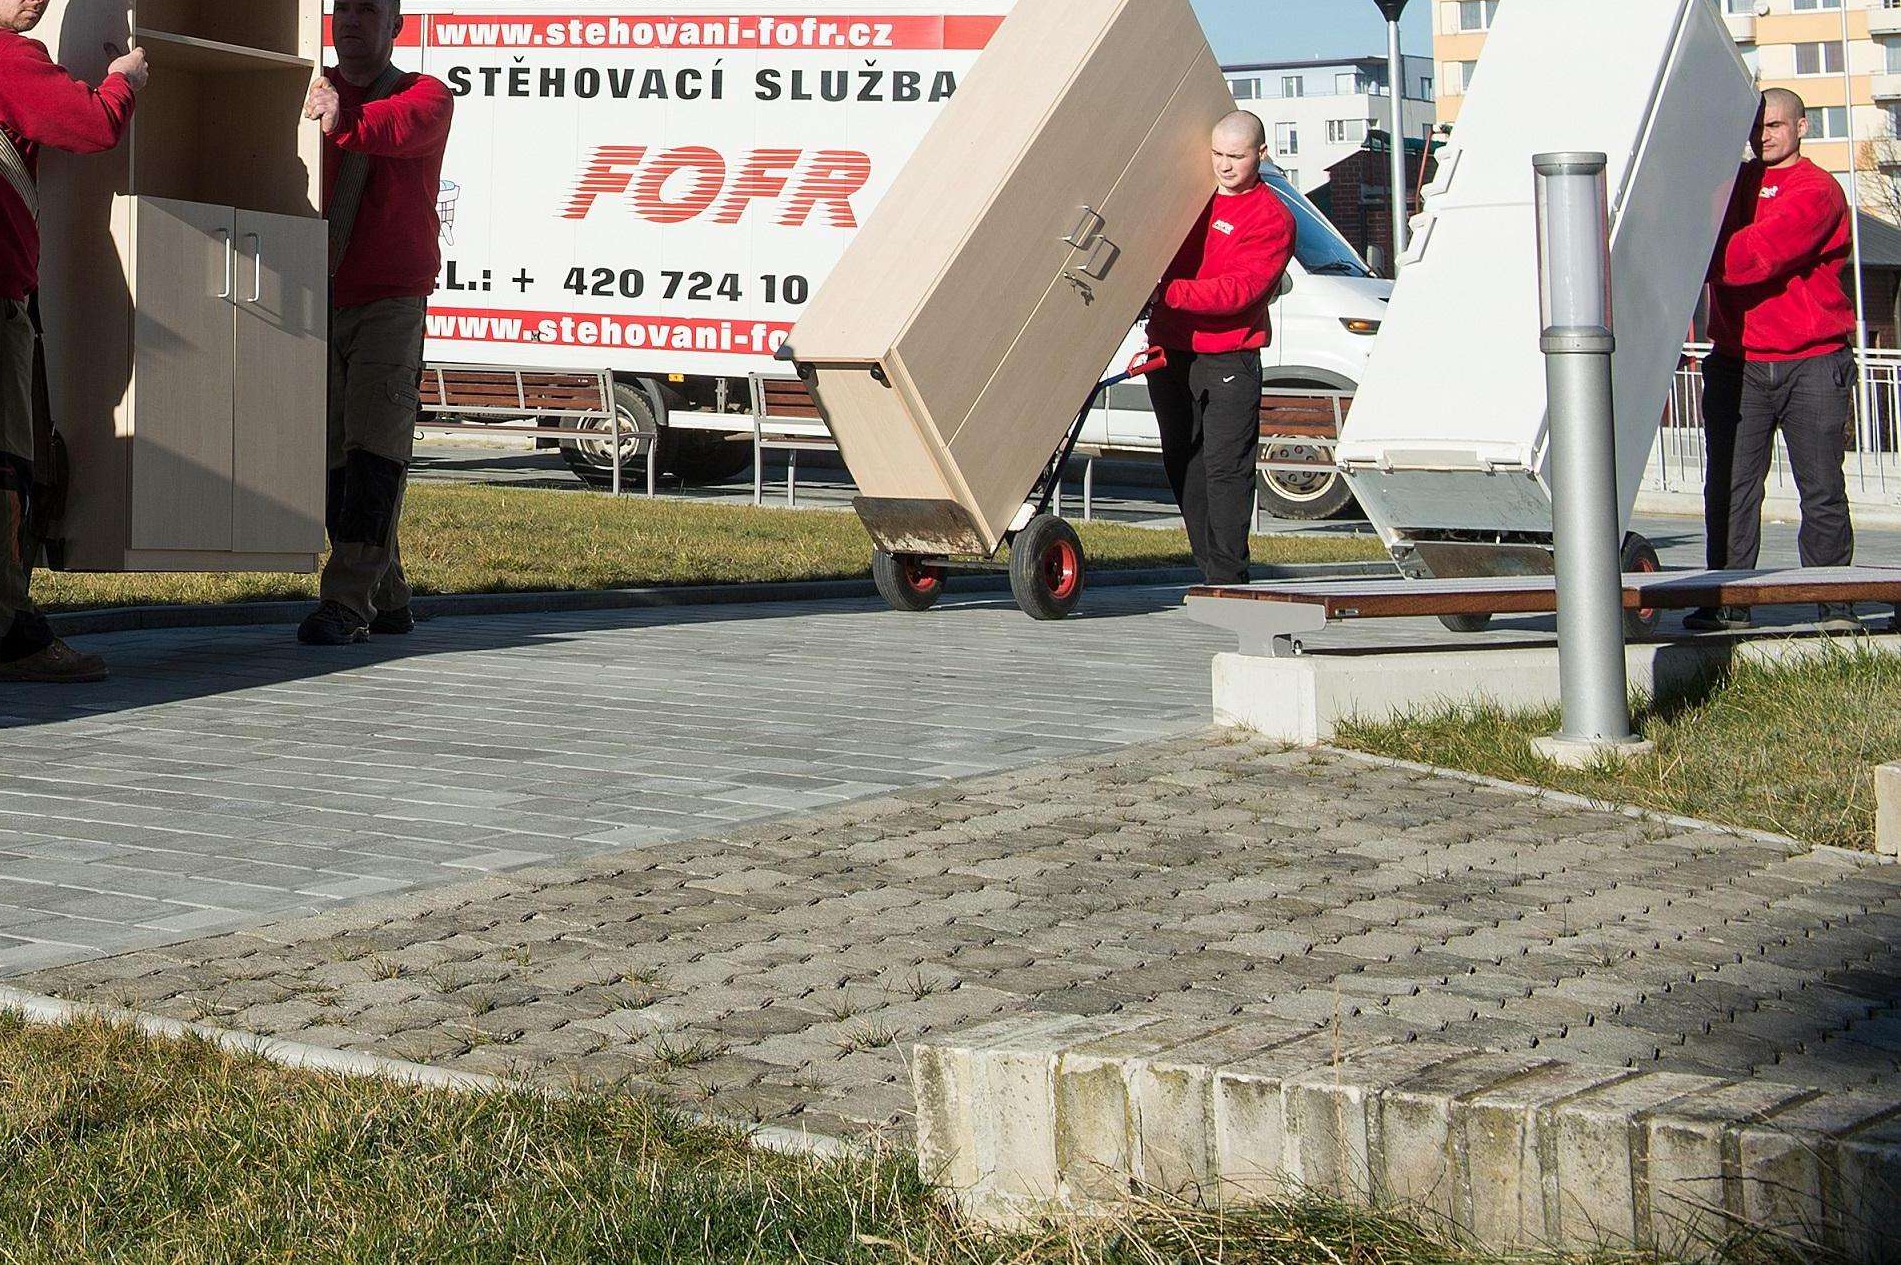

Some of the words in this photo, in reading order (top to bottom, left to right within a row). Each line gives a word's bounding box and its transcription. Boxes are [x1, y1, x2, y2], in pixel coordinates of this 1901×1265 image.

[435, 17, 894, 47] www.stehovani-fofr.cz
[447, 55, 724, 101] STĚHOVACÍ
[754, 59, 957, 103] SLUŽBA
[552, 145, 872, 228] FOFR
[434, 260, 492, 291] L.:
[563, 267, 645, 298] 420
[660, 271, 743, 302] 724
[759, 275, 809, 305] 10
